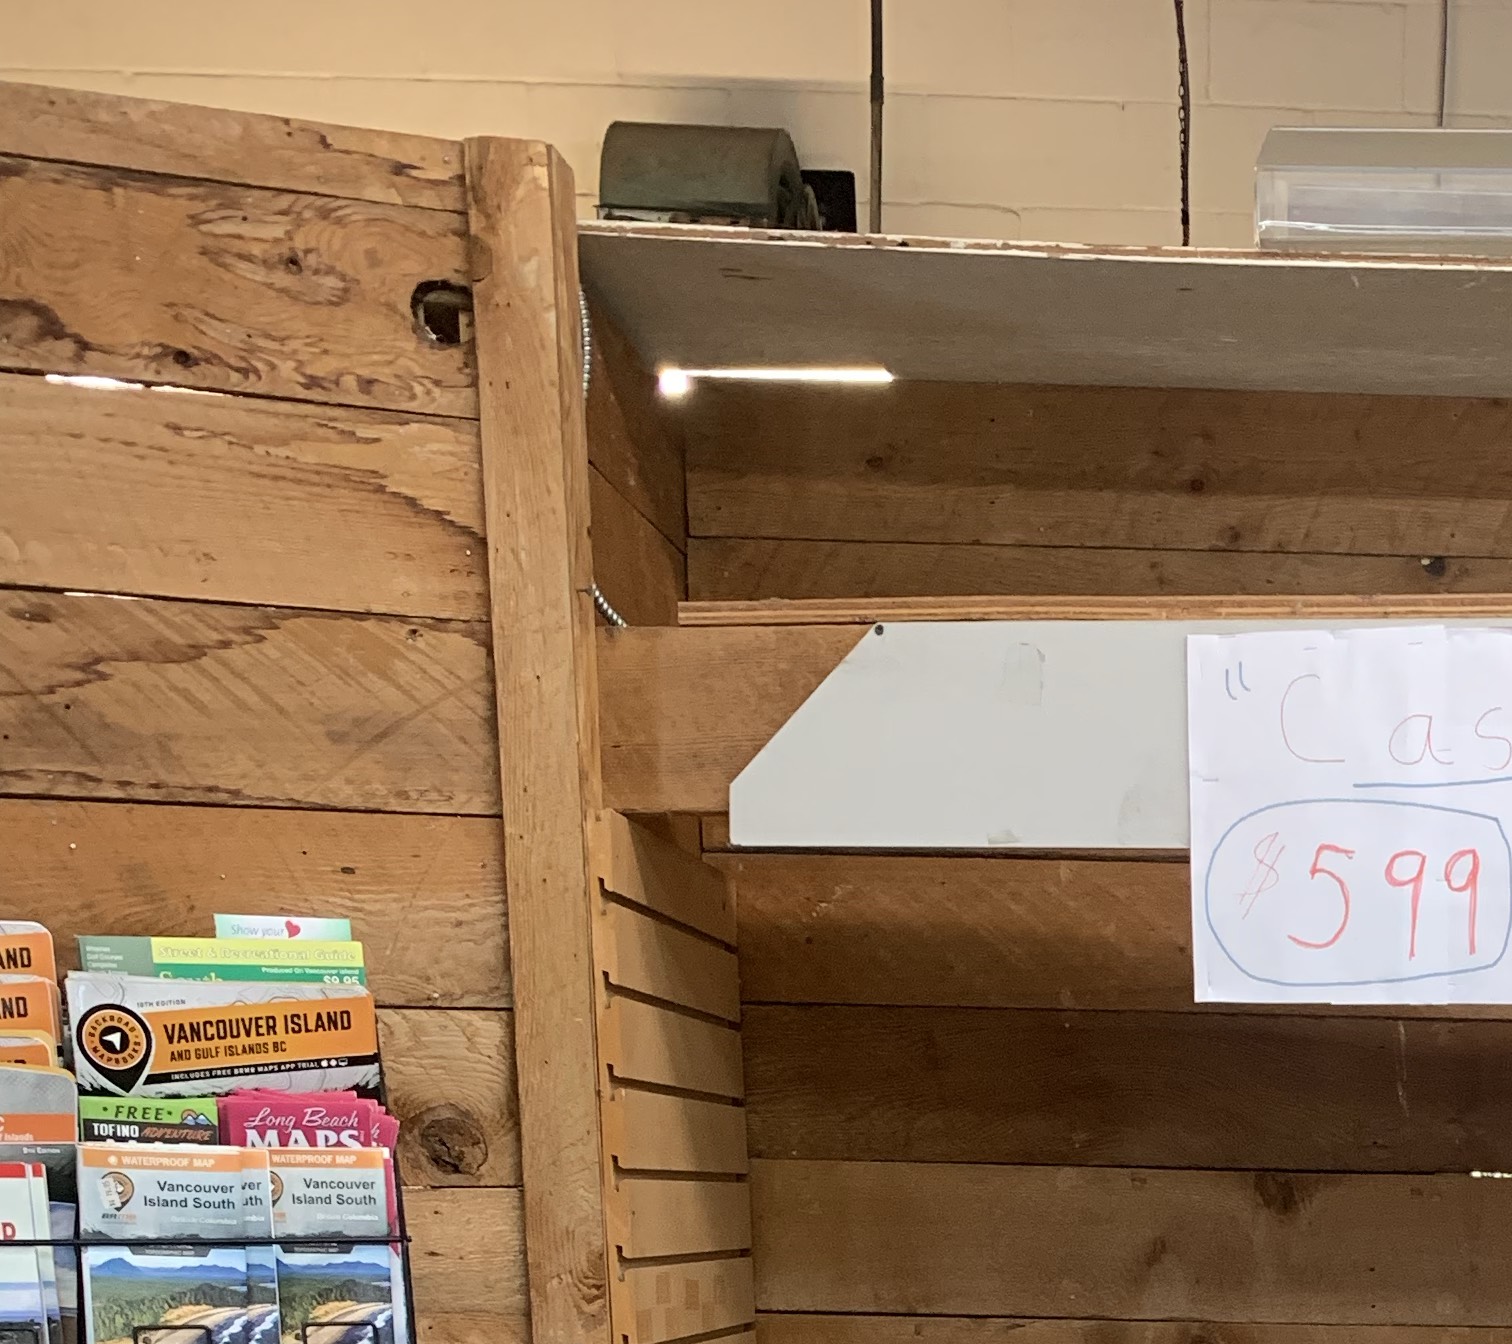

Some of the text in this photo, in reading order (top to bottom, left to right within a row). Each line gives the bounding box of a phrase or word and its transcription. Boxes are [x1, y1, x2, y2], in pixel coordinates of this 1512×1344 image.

[231, 924, 284, 938] Show your
[159, 946, 200, 959] Street
[222, 948, 310, 960] Recreational
[314, 949, 357, 961] Guide
[156, 999, 186, 1007] EDITION
[88, 1015, 137, 1038] BACKROAD
[163, 1010, 351, 1045] VANCOUVER ISLAND
[91, 1042, 141, 1064] MAPBOOKS
[170, 1041, 287, 1062] AND GULF ISLANDS BC
[115, 1105, 165, 1121] FREE
[243, 1107, 358, 1133] Long Beach
[92, 1123, 214, 1140] TOFINO ADVENTURE
[121, 1156, 215, 1168] WATERPROOF MAP
[271, 1154, 357, 1164] WATERPROOF MAP
[157, 1181, 235, 1194] Vancouver
[303, 1178, 376, 1190] Vancouver
[144, 1195, 236, 1210] Island South
[292, 1193, 377, 1206] Island South
